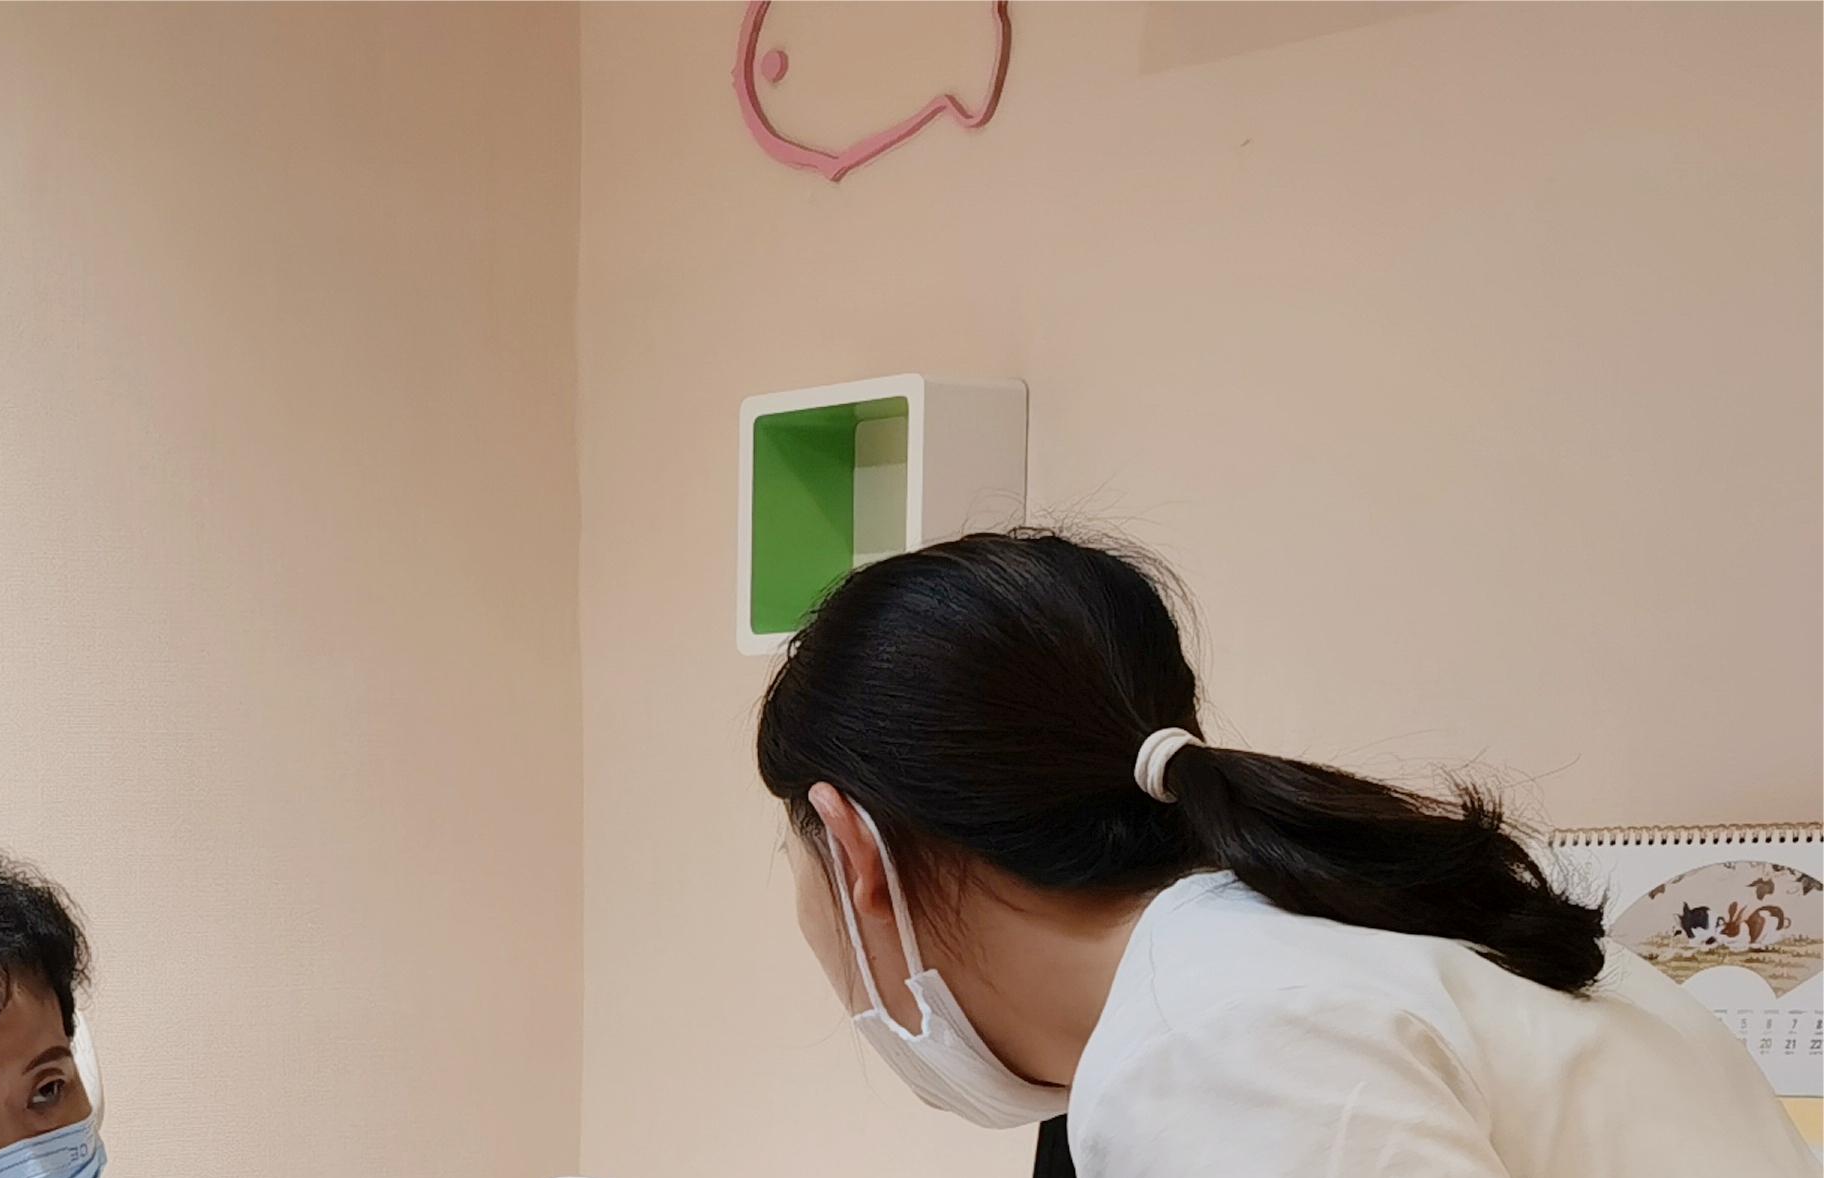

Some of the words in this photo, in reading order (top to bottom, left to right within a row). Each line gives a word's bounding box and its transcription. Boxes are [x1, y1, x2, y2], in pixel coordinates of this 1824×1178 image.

[1792, 1018, 1798, 1029] 7
[1784, 1038, 1797, 1049] 21
[1810, 1038, 1823, 1049] 22
